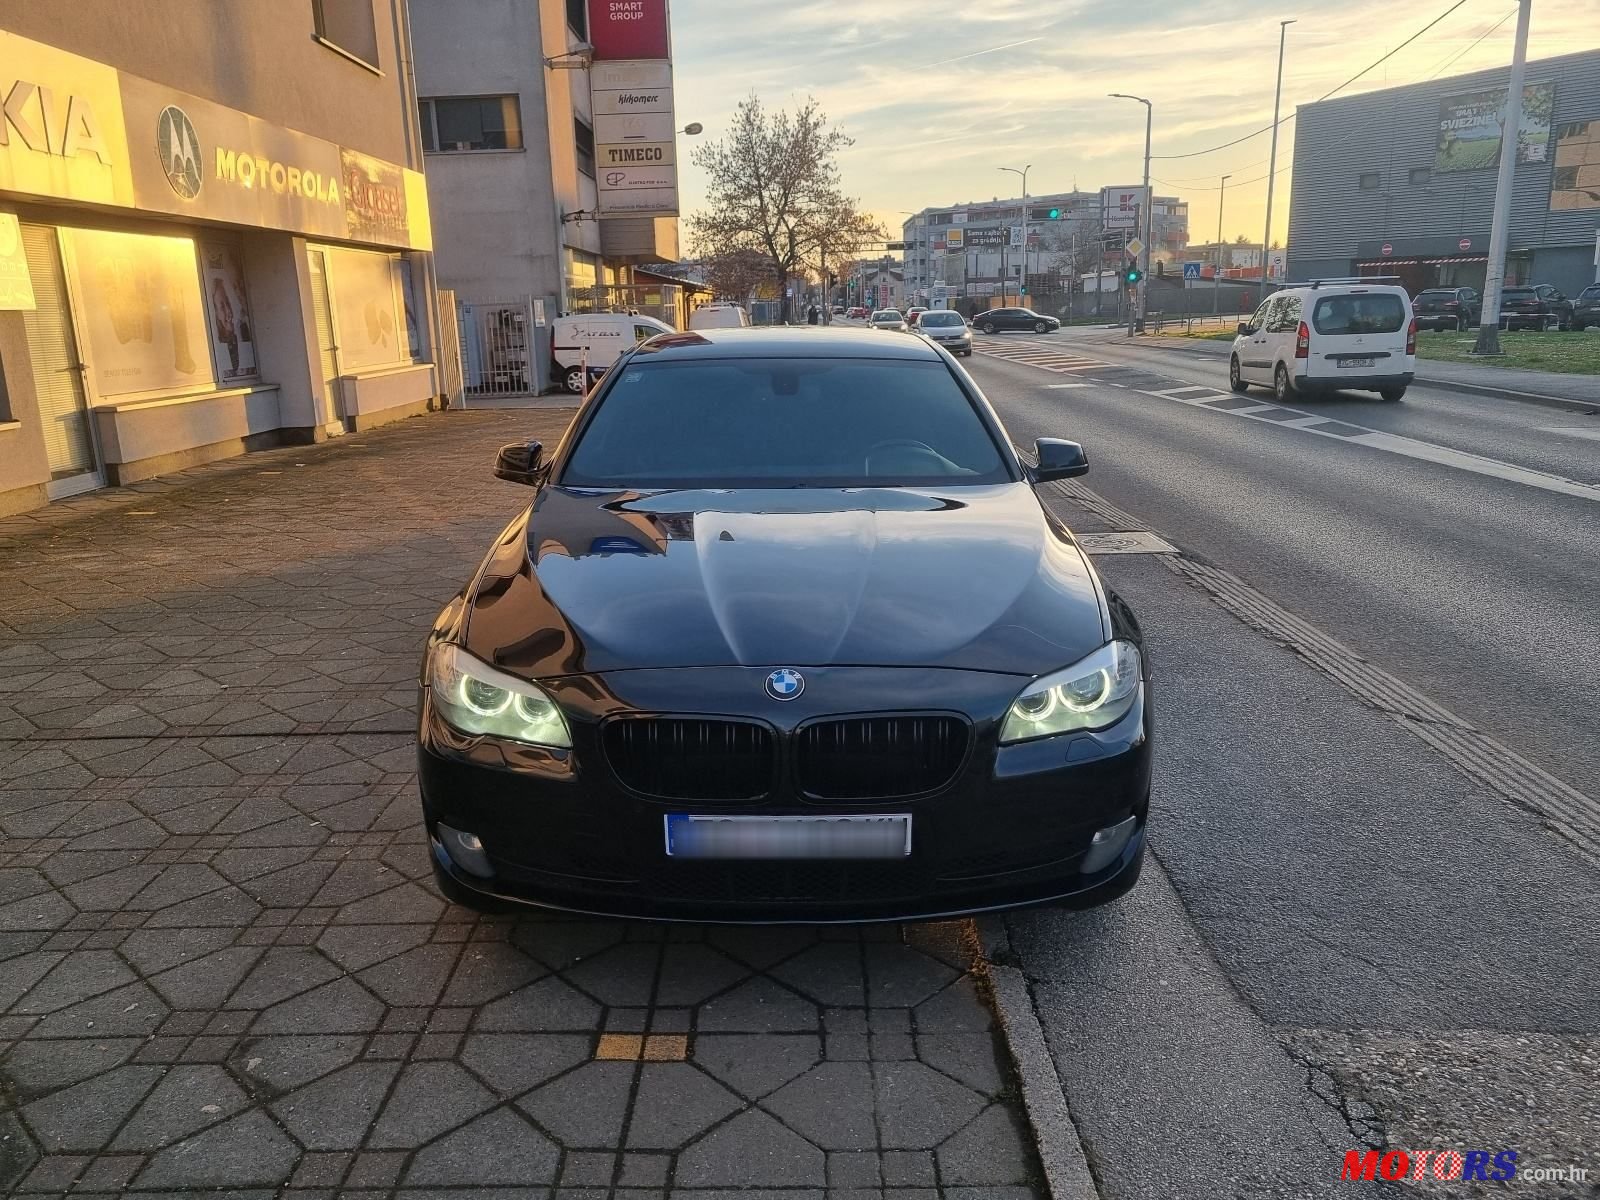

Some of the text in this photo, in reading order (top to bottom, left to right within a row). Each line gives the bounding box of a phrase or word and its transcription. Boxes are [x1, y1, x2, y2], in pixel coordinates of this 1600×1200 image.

[609, 2, 643, 11] SMART
[609, 12, 644, 20] GROUP
[618, 94, 658, 104] kirkomerc
[608, 147, 663, 162] TIMECO
[216, 146, 340, 206] MOTOROLA
